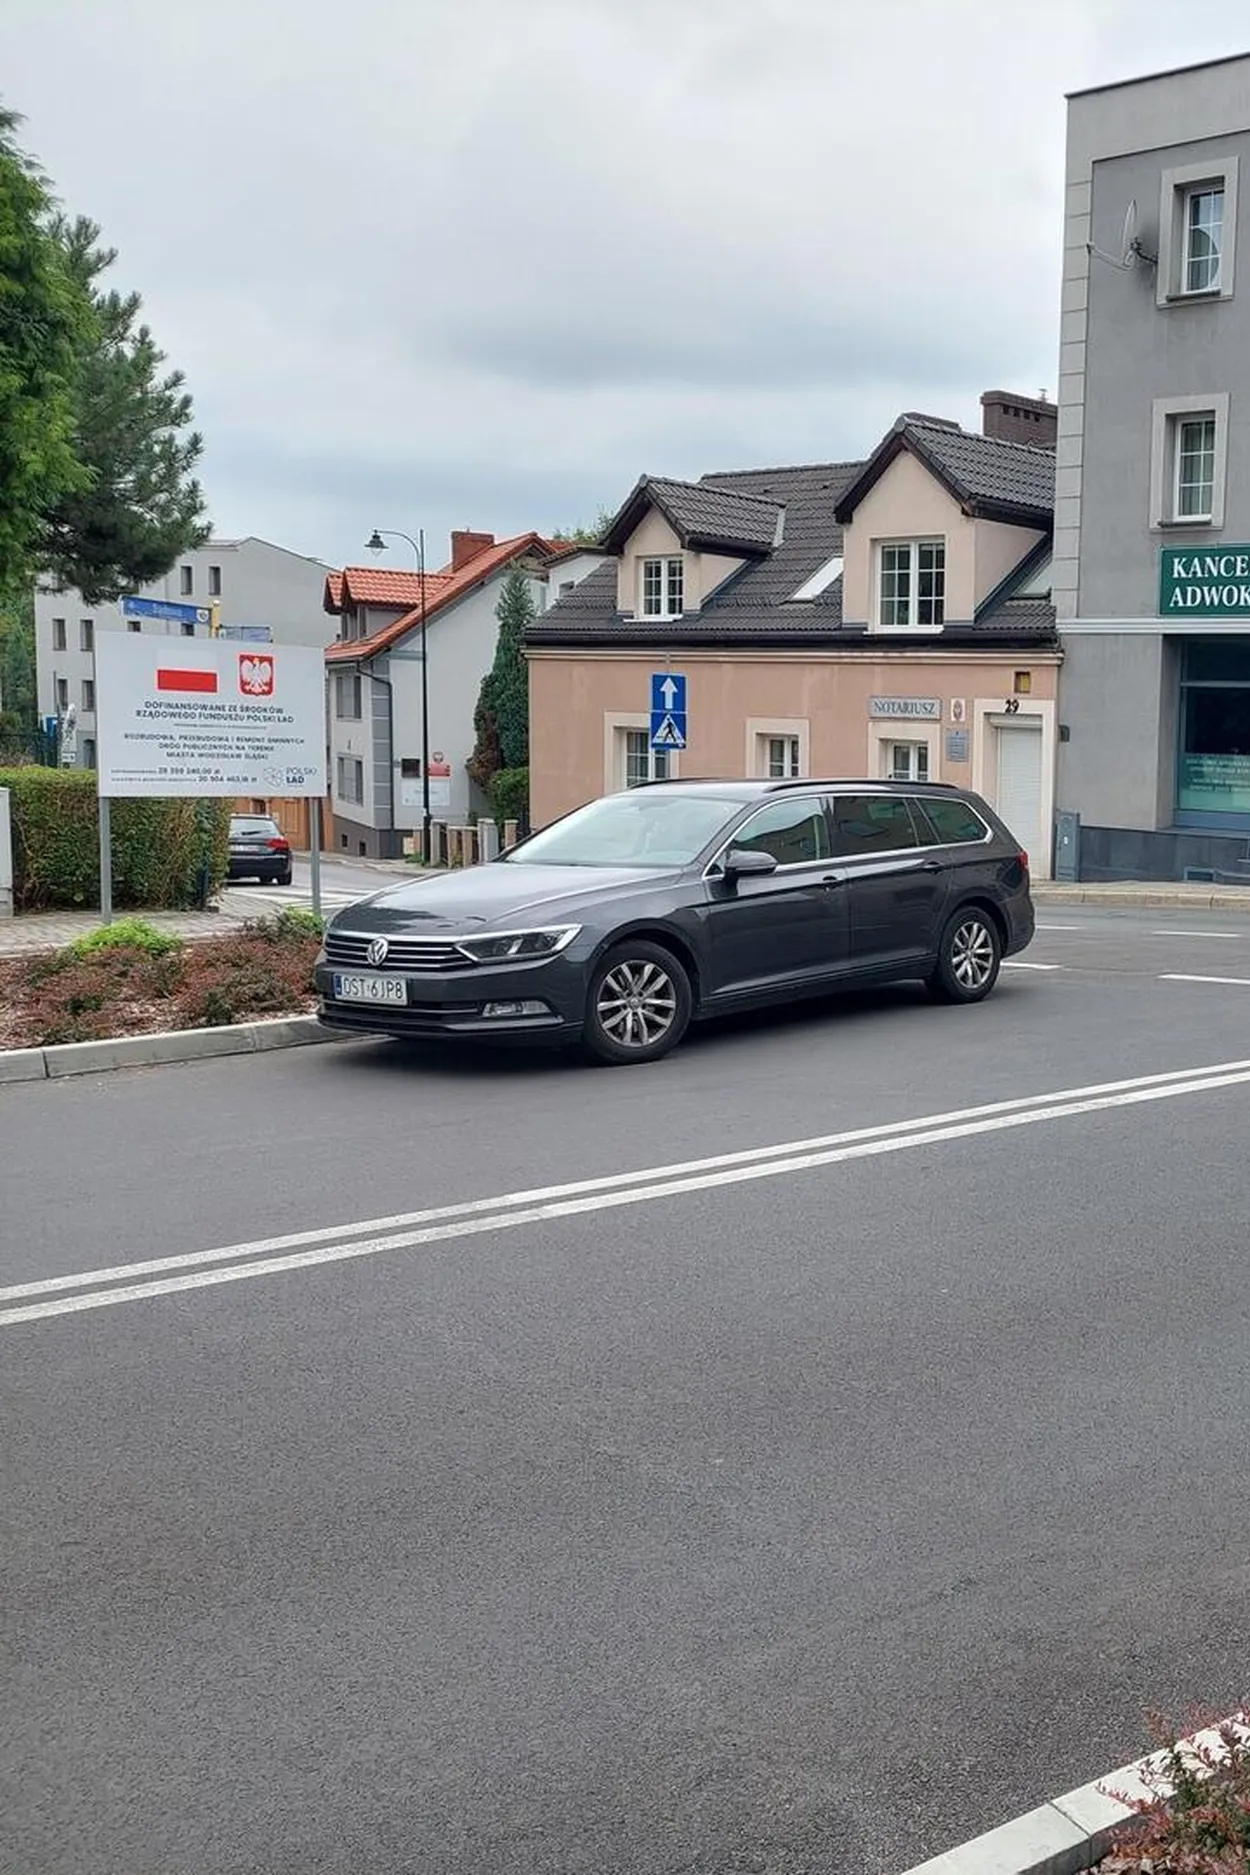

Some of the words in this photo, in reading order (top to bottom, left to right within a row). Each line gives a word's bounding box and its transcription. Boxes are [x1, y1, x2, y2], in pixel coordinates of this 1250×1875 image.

[144, 701, 226, 712] DOFINANSOWANE
[874, 701, 936, 715] NOTARIUSZ
[1005, 700, 1020, 713] 29
[199, 712, 245, 721] FUNDUSZU
[246, 714, 276, 723] POLSKI
[285, 766, 317, 776] POLSKI
[285, 775, 305, 784] ŁAD
